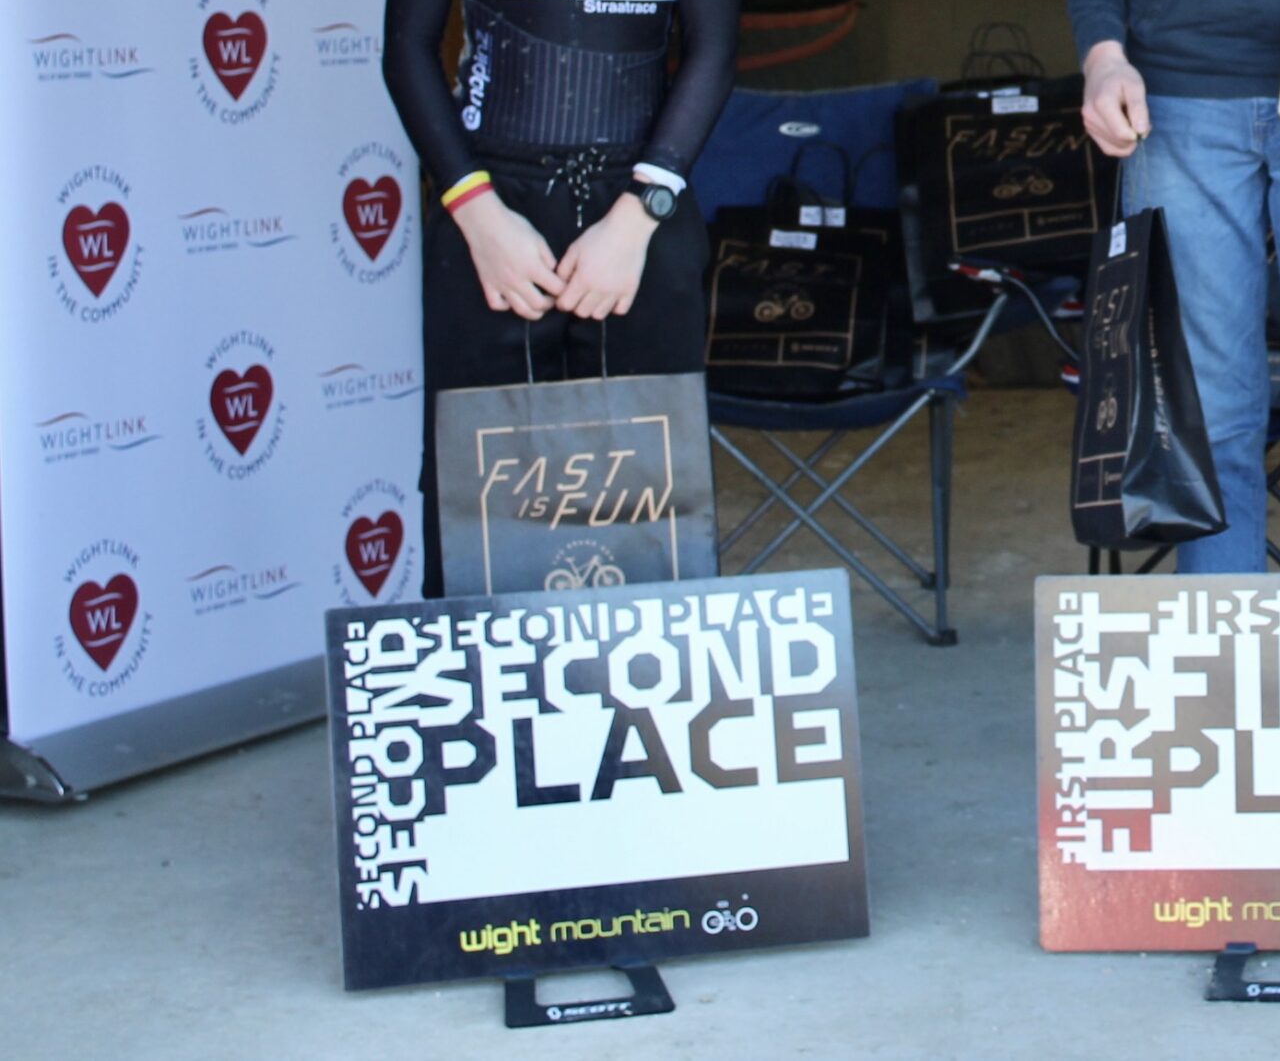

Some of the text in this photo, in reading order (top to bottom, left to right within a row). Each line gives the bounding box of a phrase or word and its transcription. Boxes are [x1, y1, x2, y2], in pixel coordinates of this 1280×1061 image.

[583, 0, 657, 14] Straatrace
[34, 47, 139, 68] WIGHTLINK
[219, 40, 251, 63] WL
[317, 36, 382, 55] WIGHTL
[183, 216, 282, 241] WIGHTLINK
[358, 204, 388, 227] WL
[79, 232, 114, 258] WL
[225, 393, 258, 420] WL
[39, 416, 147, 451] WIGHTLINK
[483, 450, 636, 495] FAST
[518, 486, 670, 530] IS FUN
[359, 540, 389, 564] WL
[189, 565, 288, 601] WIGHTLINK
[86, 604, 122, 633] WL
[416, 591, 832, 652] SECOND PLACE
[415, 622, 837, 727] SECOND
[424, 695, 846, 816] PLACE
[1154, 896, 1233, 927] wight
[460, 908, 691, 955] wight mountain
[563, 1002, 631, 1016] SCOTT
